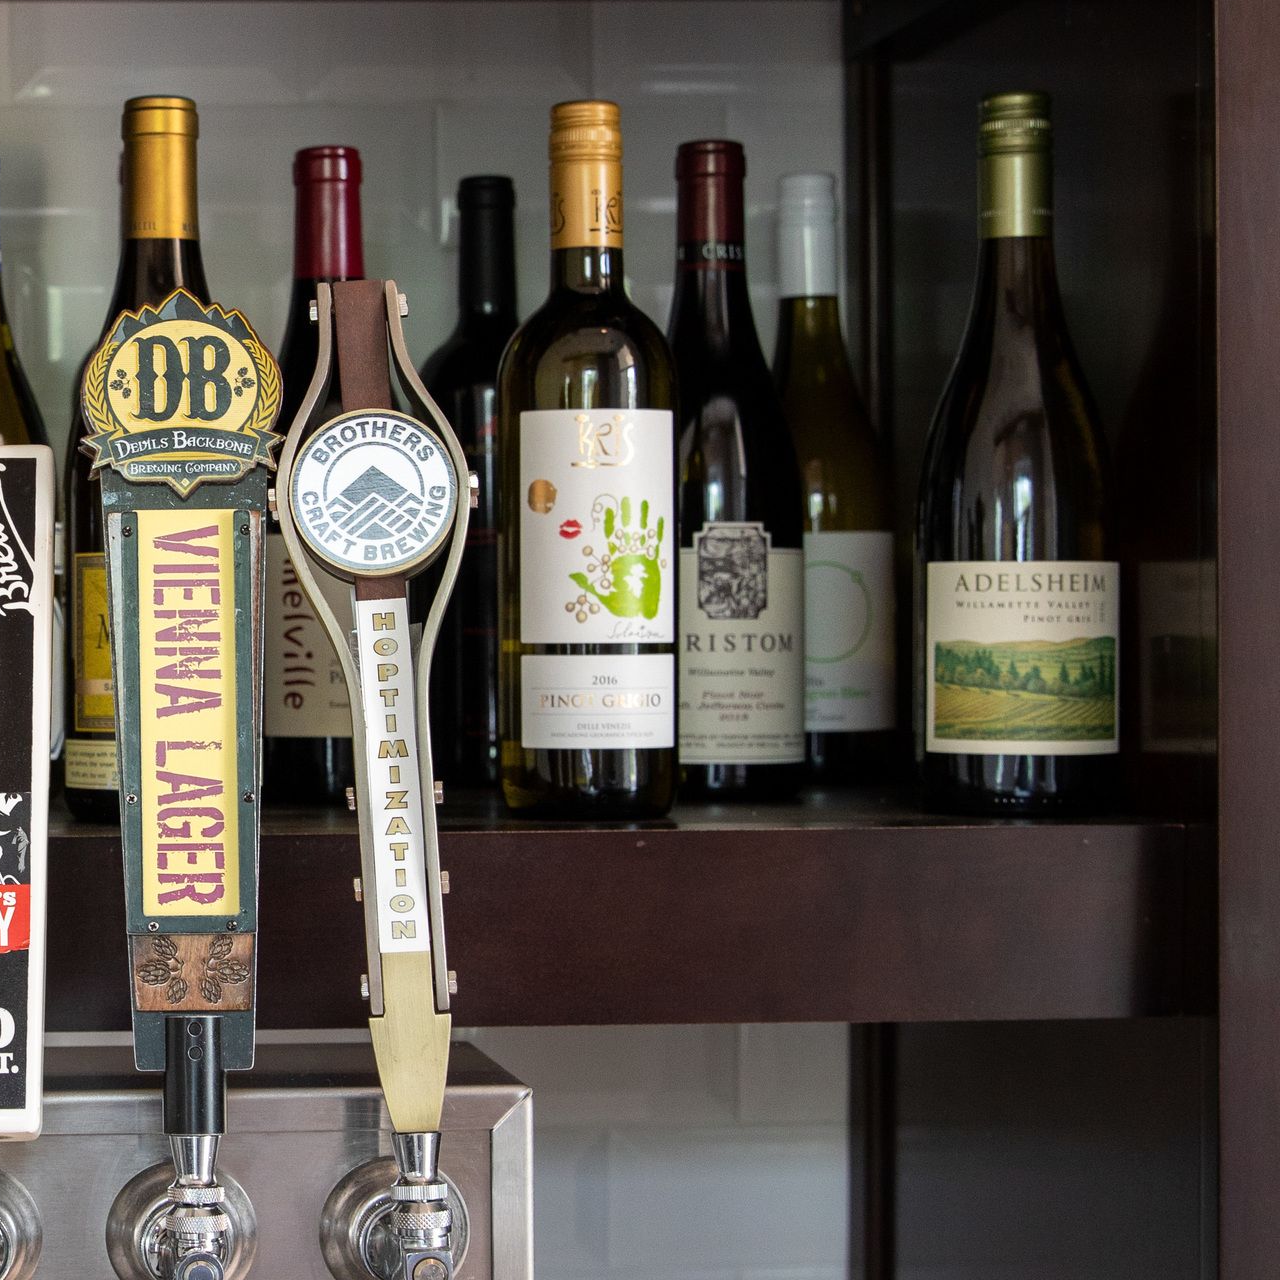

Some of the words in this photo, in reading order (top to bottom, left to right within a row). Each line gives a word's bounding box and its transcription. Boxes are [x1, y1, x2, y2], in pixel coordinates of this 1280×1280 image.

[129, 334, 233, 422] DB
[114, 436, 169, 460] DEVILS
[172, 430, 254, 456] BACKBONE
[310, 420, 435, 466] BROTHERS
[129, 462, 182, 475] BREWING
[184, 462, 238, 474] COMPANY
[301, 490, 358, 556] CRAFT
[362, 484, 447, 561] BREWING
[954, 573, 1106, 593] ADELSHEIM
[152, 524, 223, 720] VIENNA
[685, 633, 793, 653] RISTOM
[591, 675, 619, 686] 2016
[538, 693, 596, 710] PINOT
[601, 692, 662, 708] GRIGIO
[371, 611, 418, 941] HOPTIMIZATION
[155, 739, 227, 906] LAGER
